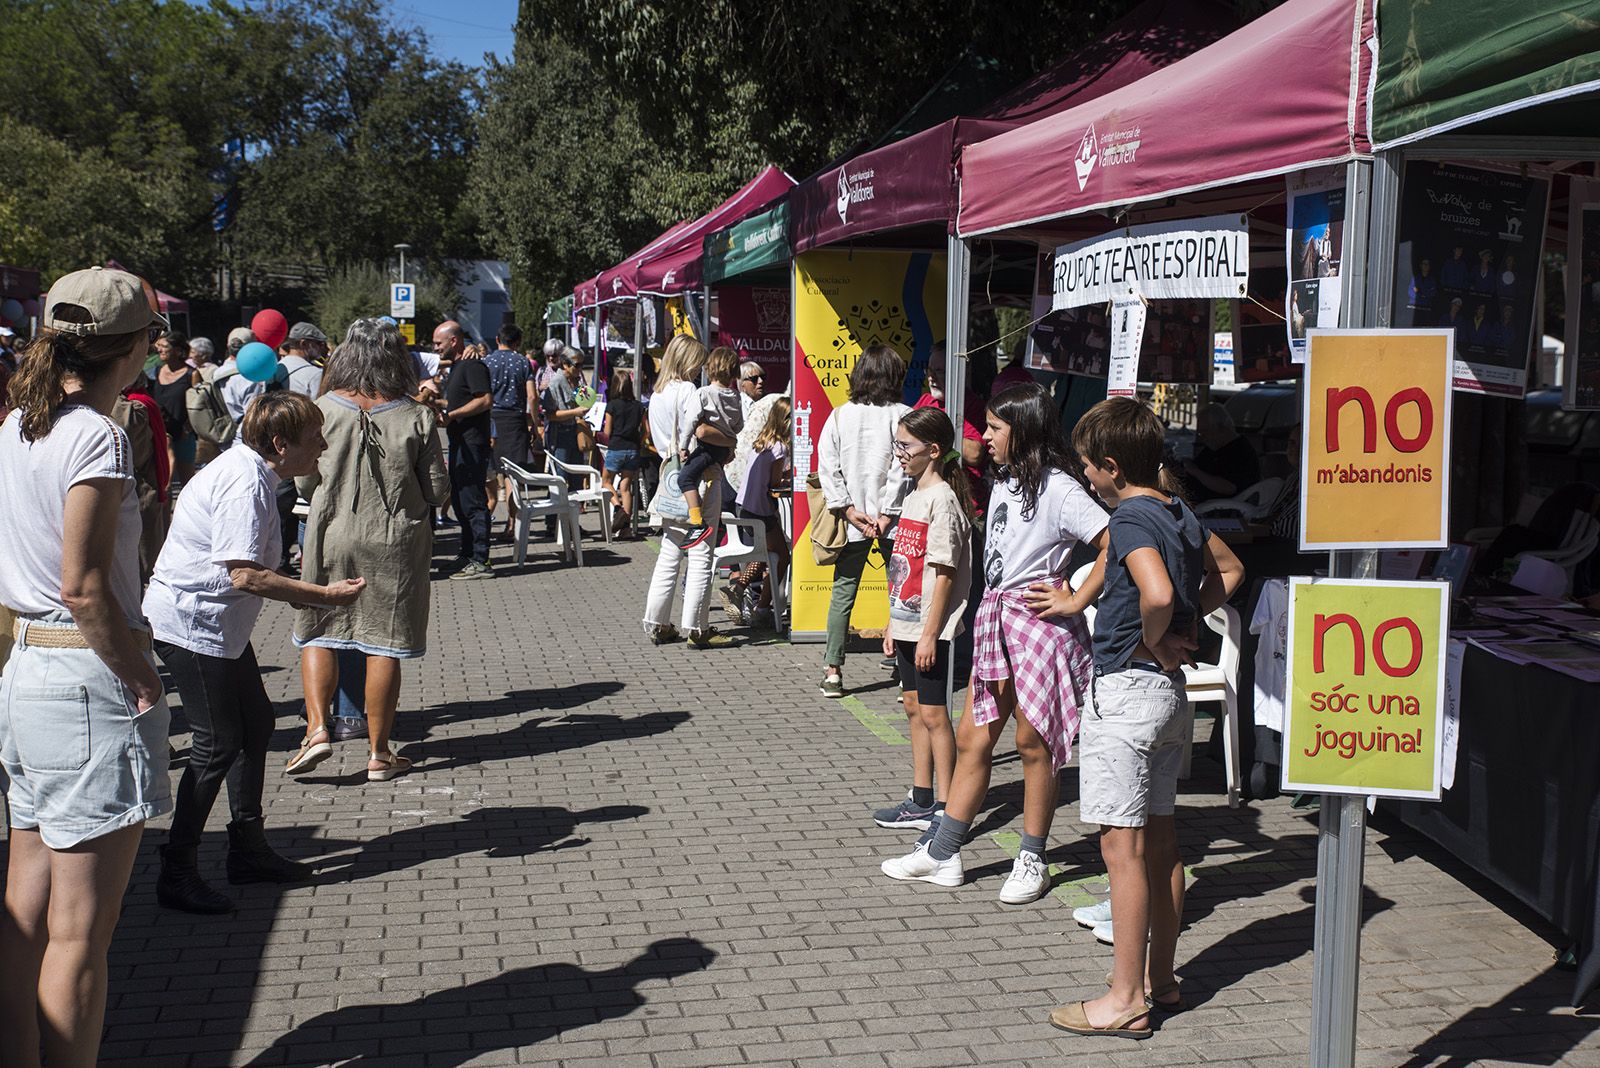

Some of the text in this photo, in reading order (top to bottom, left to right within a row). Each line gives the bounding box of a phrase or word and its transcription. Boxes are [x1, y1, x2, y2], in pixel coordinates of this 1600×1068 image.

[850, 182, 875, 204] Valldoreix
[1477, 198, 1493, 211] de
[1440, 211, 1481, 227] bruixes
[1103, 241, 1161, 285] TEATRE
[1162, 234, 1247, 279] ESPIRAL
[397, 287, 408, 301] P
[806, 286, 840, 296] Cultural
[731, 336, 791, 351] VALLDAU
[803, 353, 848, 369] Coral
[821, 371, 840, 387] de
[1324, 385, 1434, 454] no
[1316, 463, 1433, 485] m'abandonis
[799, 584, 814, 592] Cor
[1312, 613, 1423, 678] no
[1310, 683, 1420, 716] sóc una
[1304, 722, 1422, 759] joguina!
